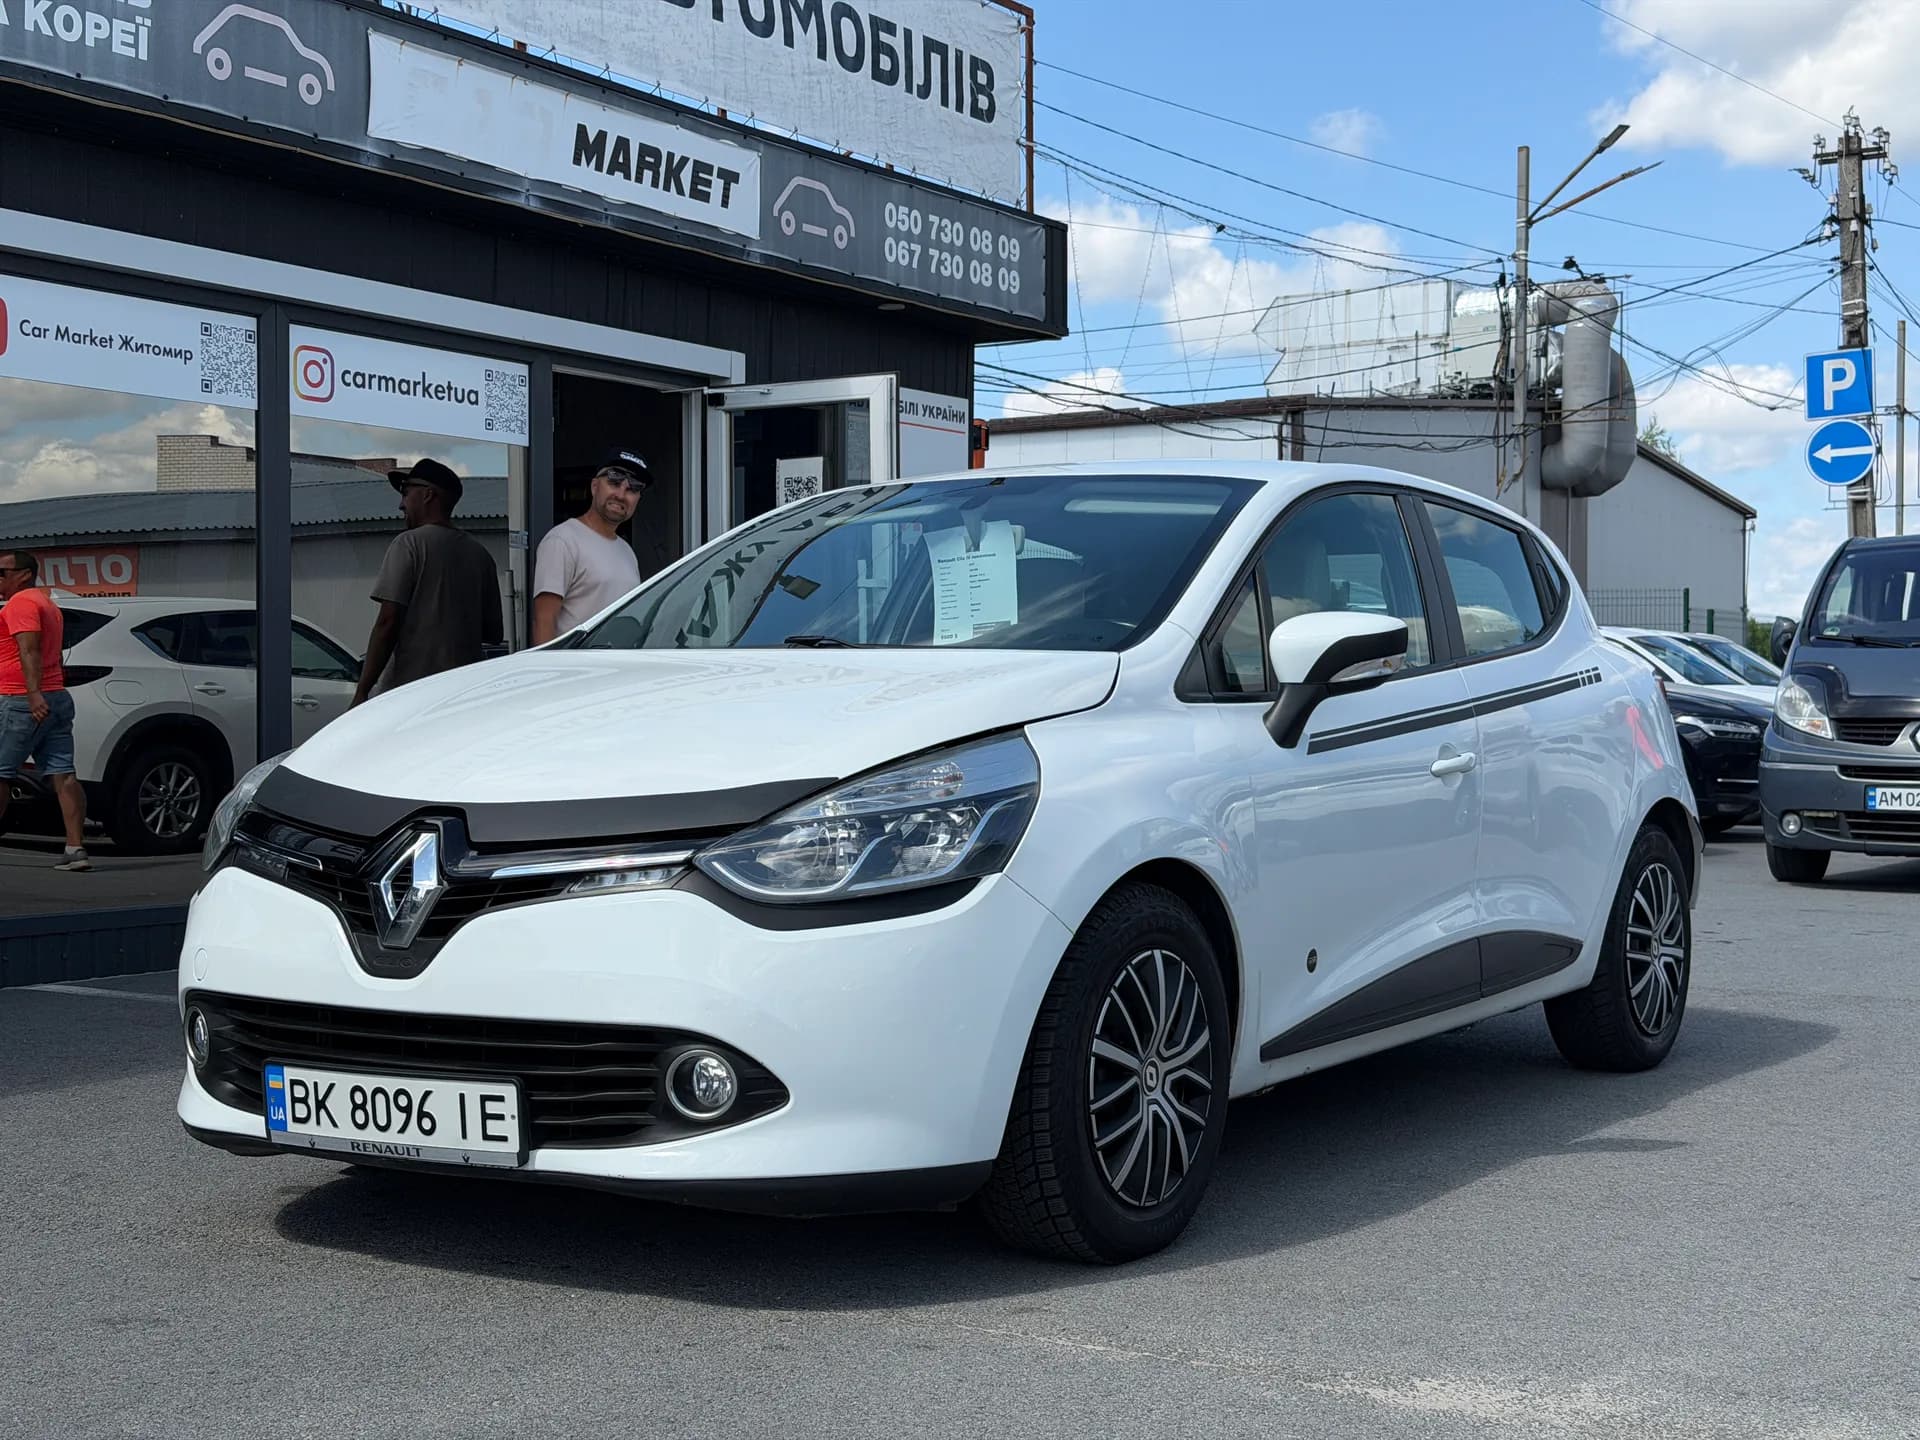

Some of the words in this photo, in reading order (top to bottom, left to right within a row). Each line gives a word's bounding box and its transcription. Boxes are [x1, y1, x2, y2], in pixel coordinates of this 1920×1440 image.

[24, 0, 152, 61] КОРЕЇ
[663, 0, 996, 124] ОМОБІЛІВ
[572, 123, 741, 209] MARKET
[884, 202, 922, 235] 050
[928, 214, 964, 247] 730
[969, 227, 993, 255] 08
[998, 235, 1021, 262] 09
[884, 237, 922, 269] 067
[928, 248, 964, 280] 730
[969, 259, 993, 287] 08
[998, 267, 1021, 294] 09
[19, 319, 50, 339] Car
[54, 324, 114, 349] Market
[118, 334, 194, 365] Житомир
[340, 369, 480, 406] carmarketua
[1823, 358, 1856, 411] P
[921, 403, 966, 425] УКРАЇНИ
[1878, 791, 1903, 807] AM
[270, 1106, 286, 1121] UA
[289, 1078, 339, 1129] BK
[349, 1084, 437, 1137] 8096
[458, 1092, 509, 1143] IE
[350, 1141, 424, 1158] RENAULT
